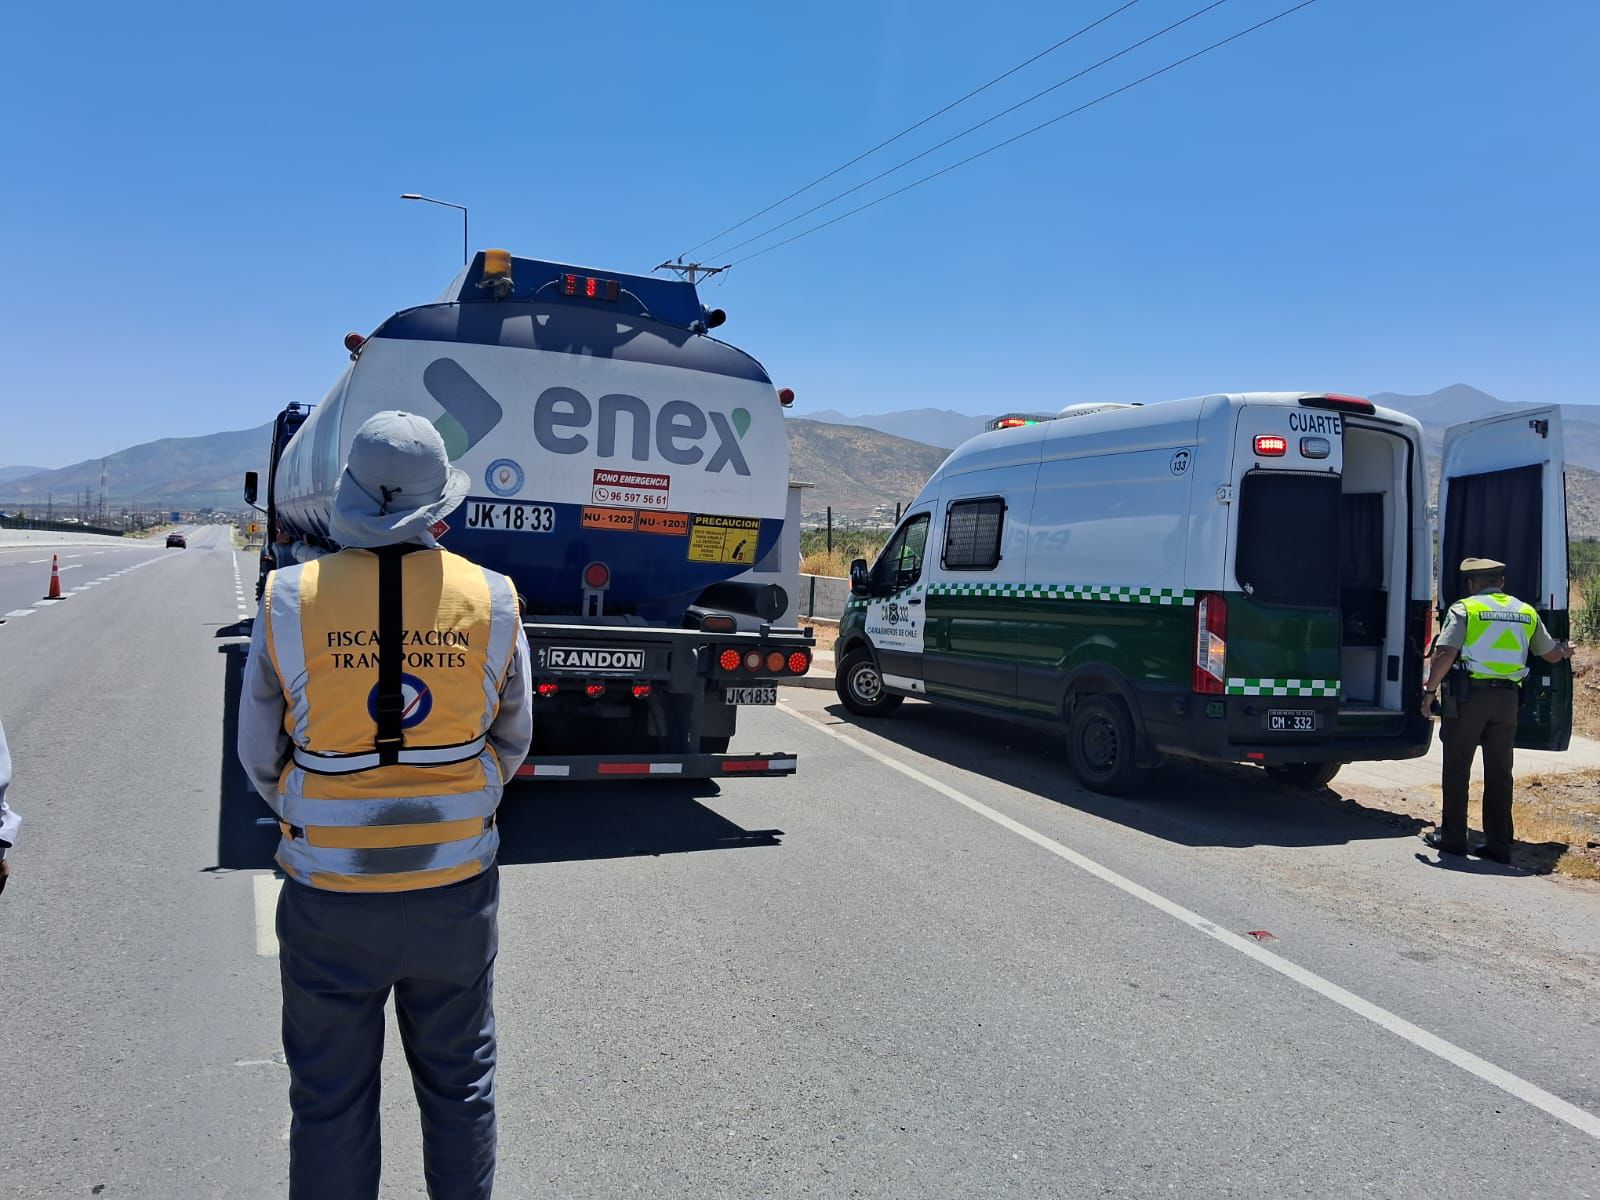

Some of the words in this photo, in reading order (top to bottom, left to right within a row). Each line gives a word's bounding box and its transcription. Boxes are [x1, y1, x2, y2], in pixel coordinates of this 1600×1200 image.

[534, 387, 751, 476] enex
[1289, 412, 1341, 435] CUARTE
[1173, 461, 1186, 471] 133
[596, 473, 619, 483] FONO
[620, 475, 668, 487] EMERGENCIA
[610, 491, 622, 501] 96
[624, 493, 641, 503] 597
[643, 494, 654, 504] 56
[656, 495, 667, 505] 61
[695, 516, 759, 528] PRECAUCION
[327, 628, 470, 647] FISCAZACIÓN
[331, 652, 466, 669] TRANORTES
[551, 650, 642, 668] RANDON
